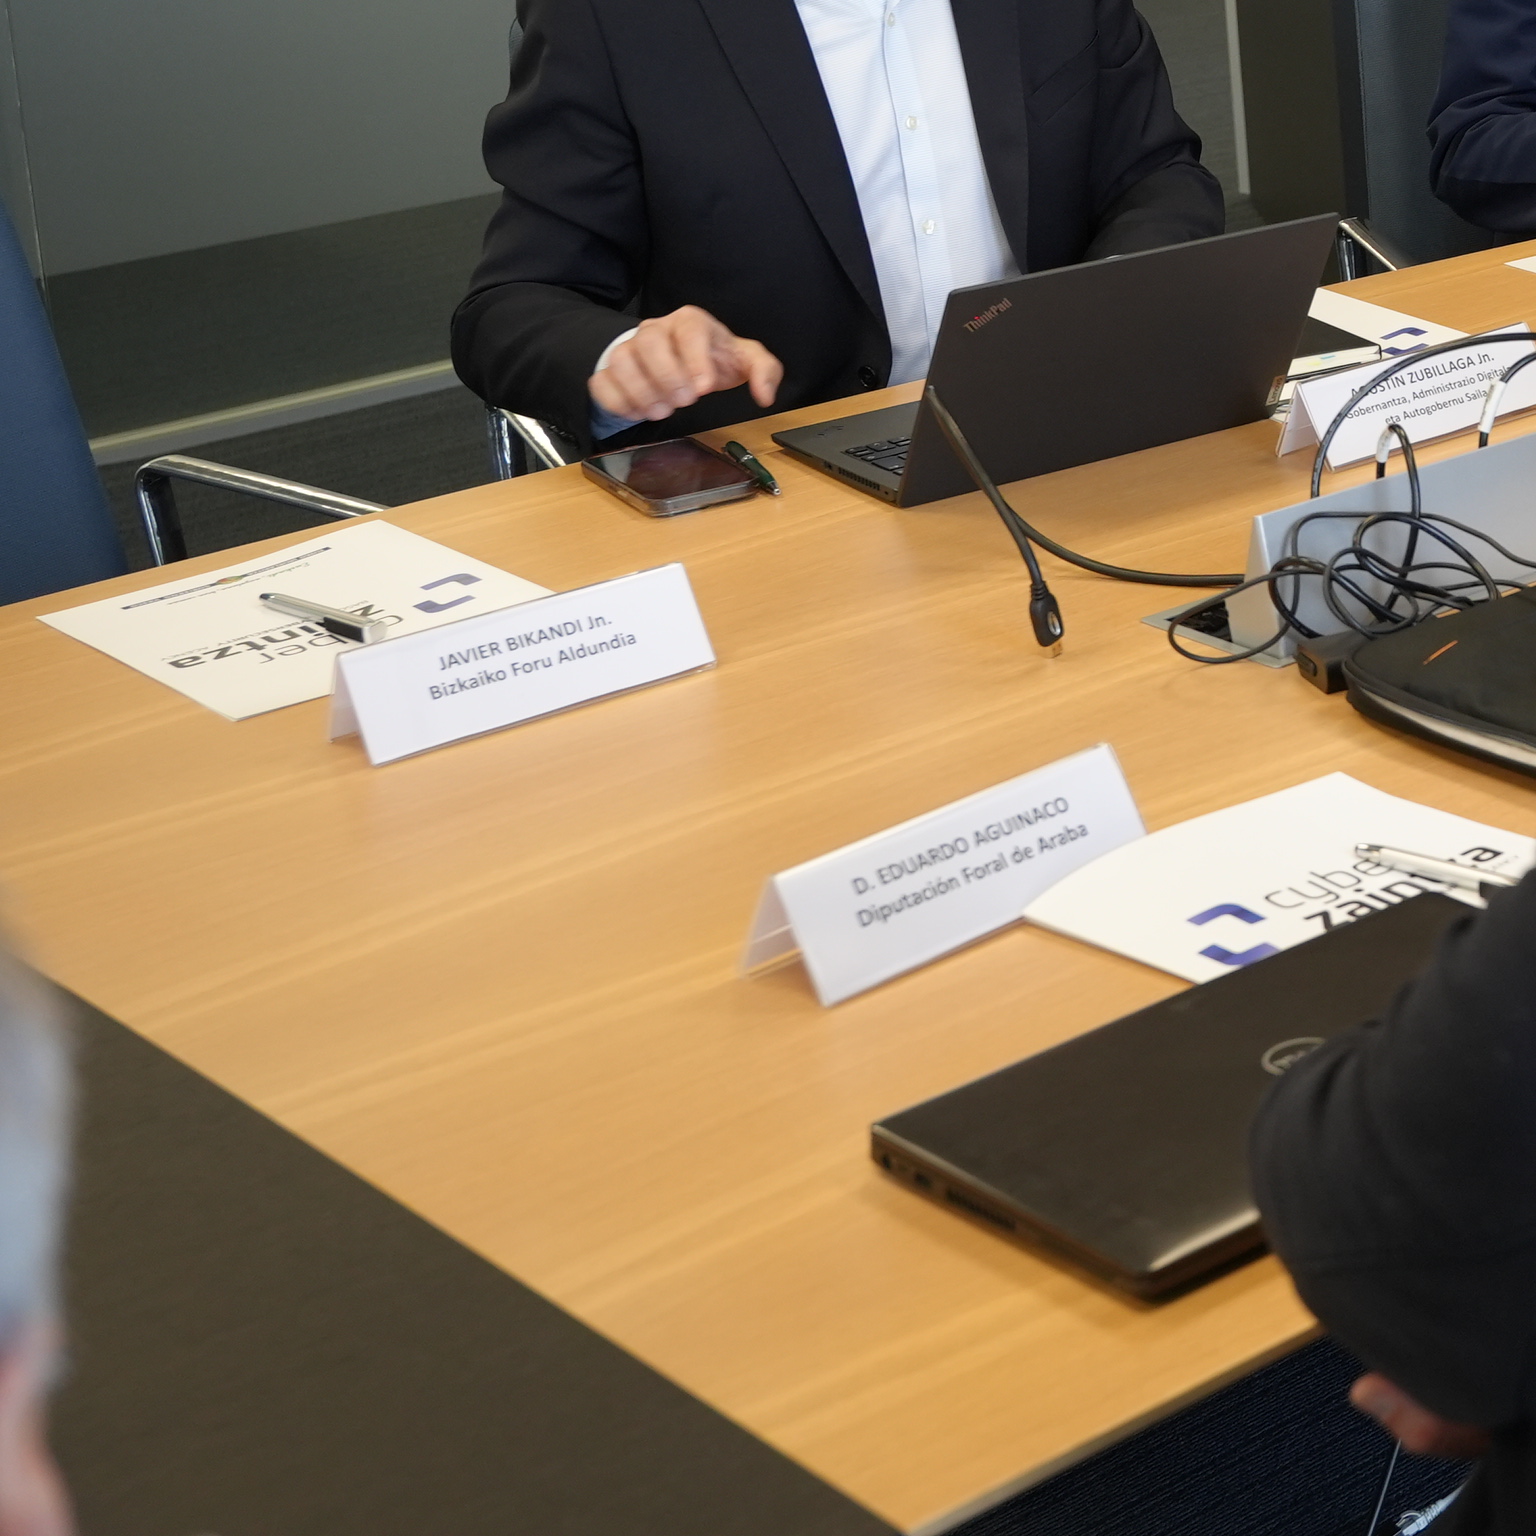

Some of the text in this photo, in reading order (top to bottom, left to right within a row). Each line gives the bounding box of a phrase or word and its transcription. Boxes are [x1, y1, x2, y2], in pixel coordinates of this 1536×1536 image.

[963, 297, 1012, 332] ThinkPad
[1407, 355, 1476, 384] ZUBILLAGA
[1478, 352, 1495, 365] Jn.
[1412, 377, 1476, 401] Administrazio
[1385, 415, 1401, 426] eta
[1408, 397, 1465, 423] Autogobernu
[439, 615, 613, 671] JAVIER BIKANDI Jn.
[429, 632, 637, 700] Bizkaiko Foru Aldundia
[852, 796, 1070, 895] D. EDUARDO AGUINACO
[856, 823, 1089, 928] Diputación Foral de Araba
